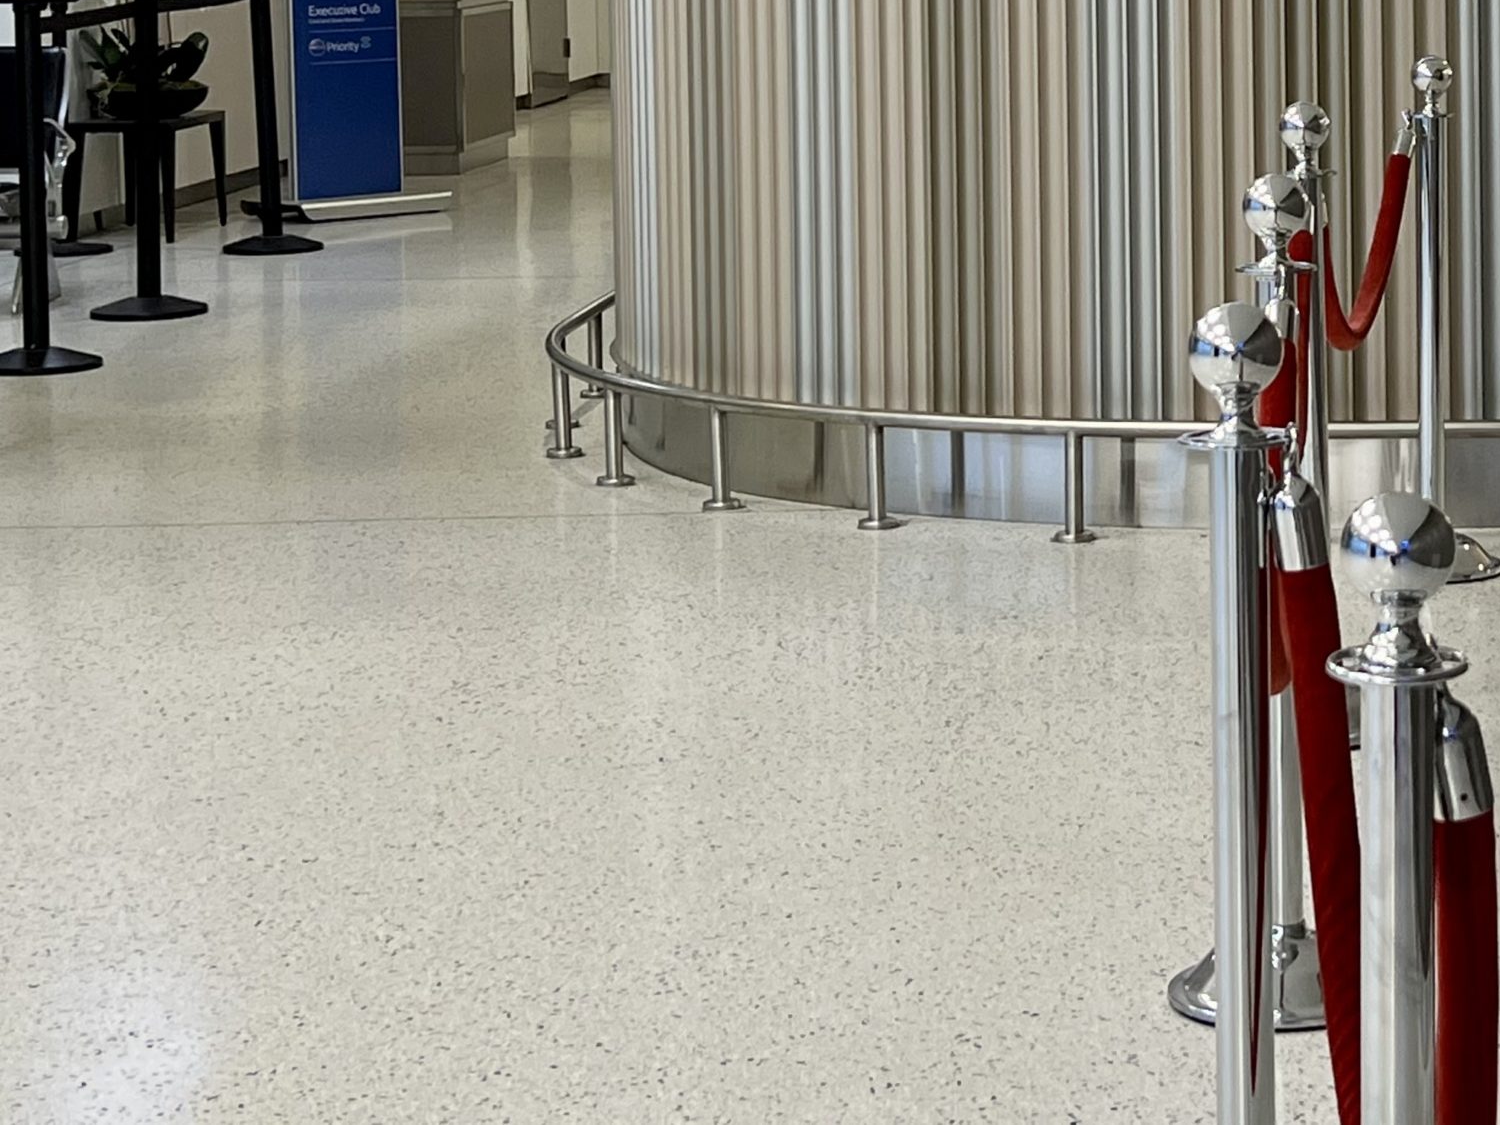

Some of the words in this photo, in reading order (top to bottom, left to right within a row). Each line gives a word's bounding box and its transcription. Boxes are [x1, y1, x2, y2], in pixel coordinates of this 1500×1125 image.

[308, 5, 357, 16] Executive
[360, 3, 381, 14] Club
[327, 41, 359, 53] Priority
